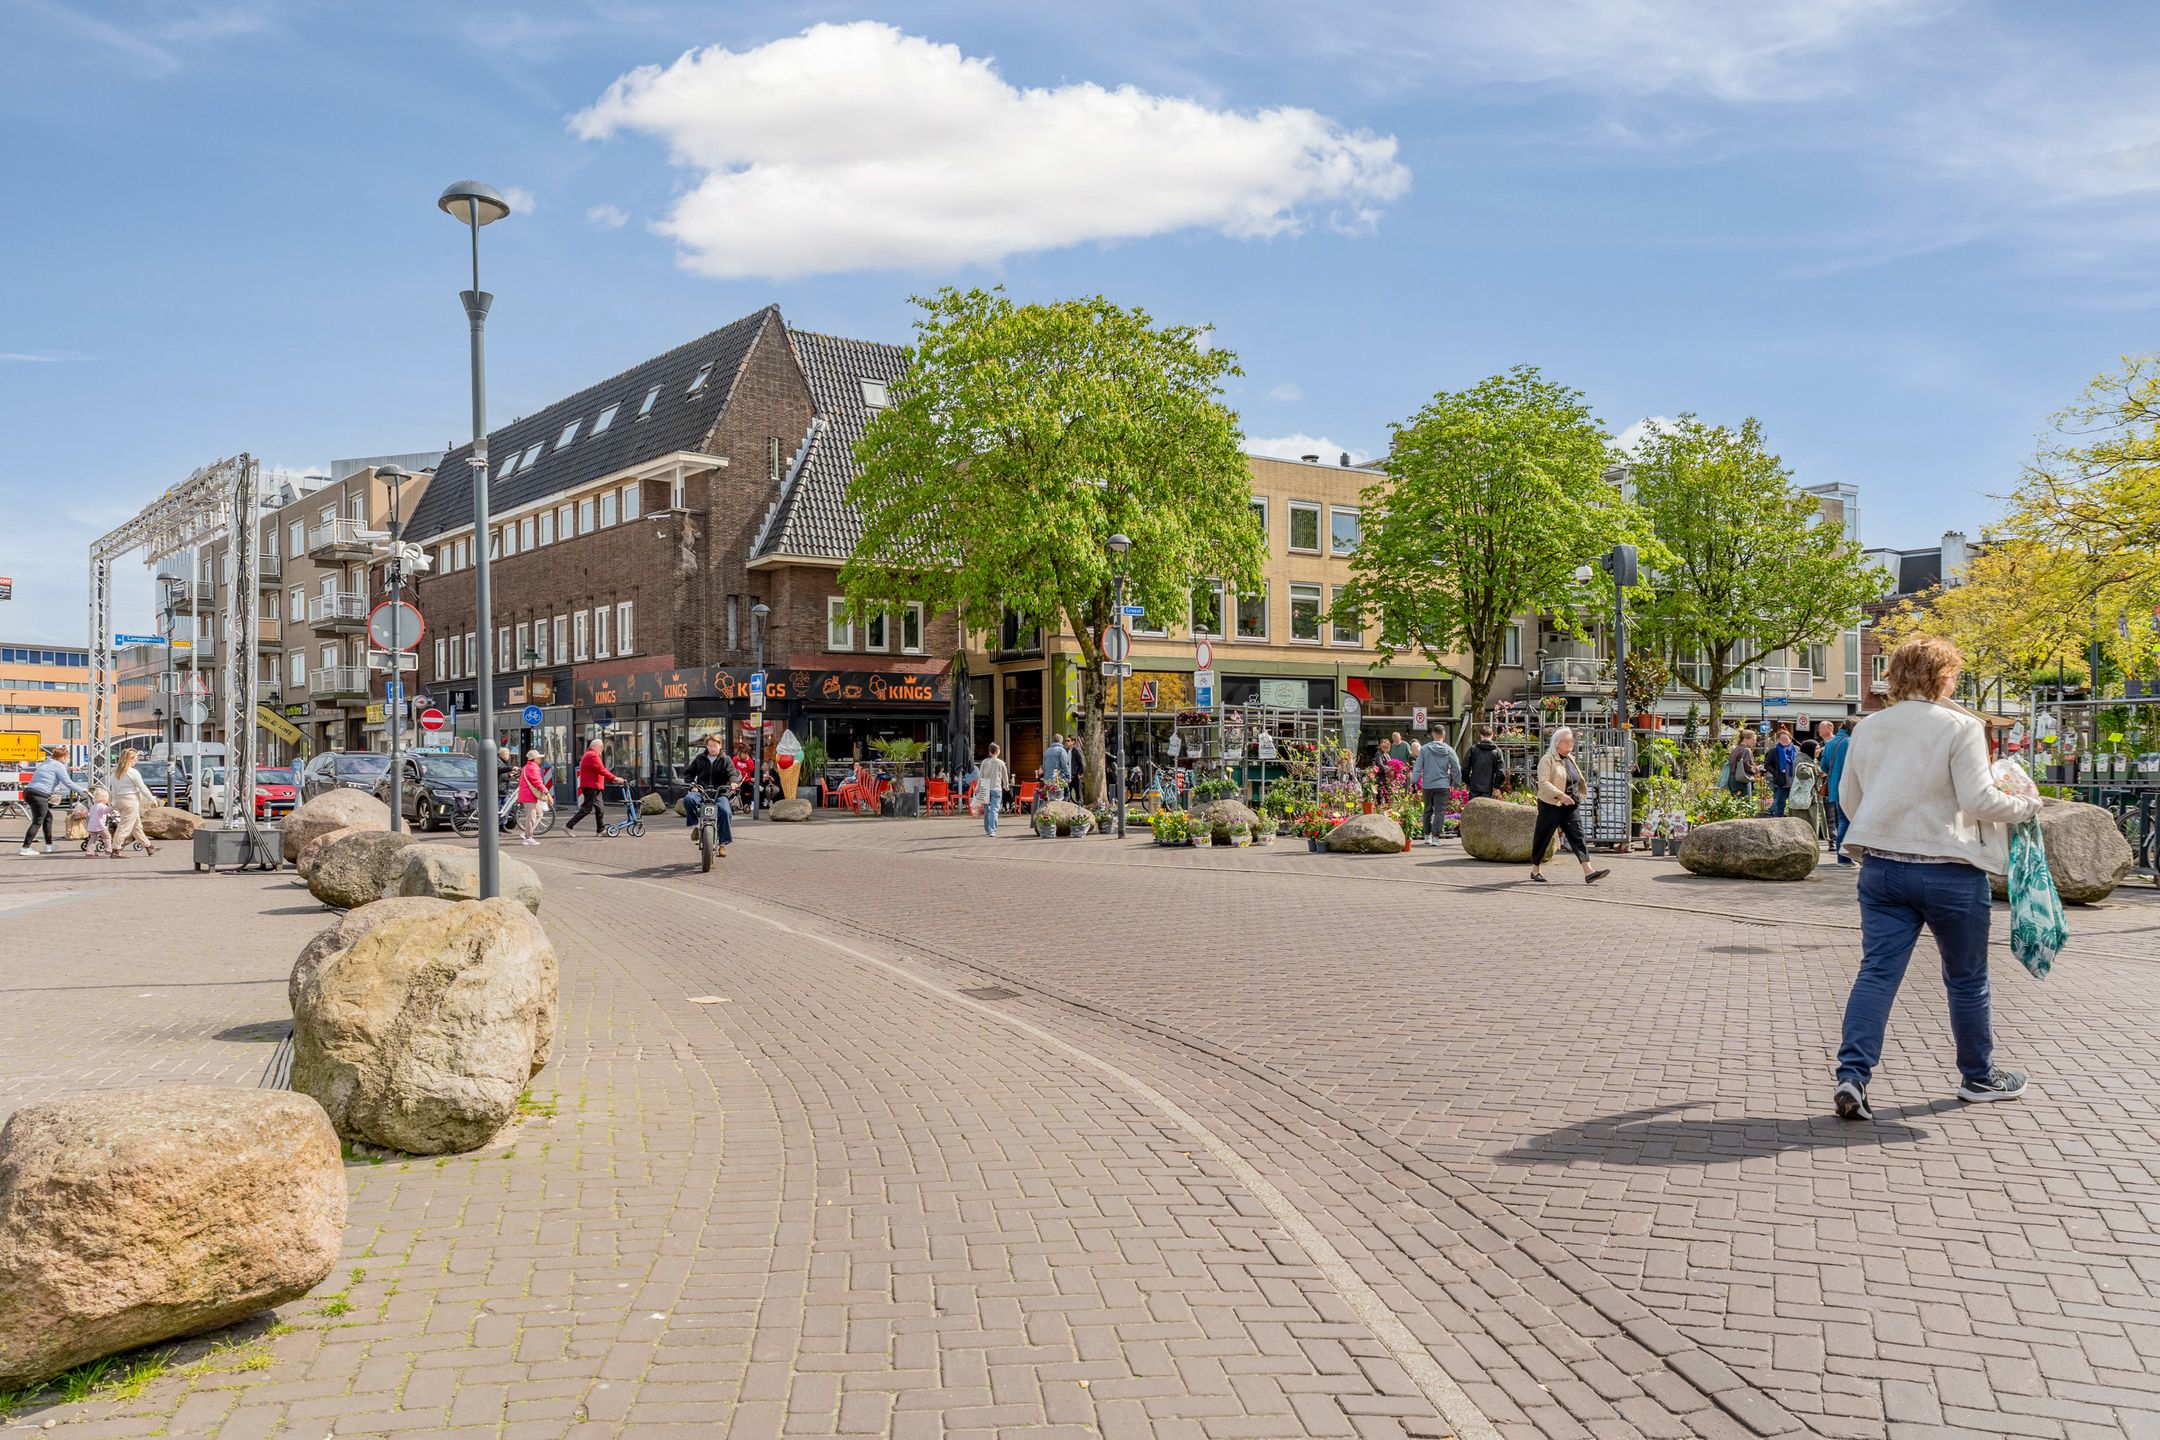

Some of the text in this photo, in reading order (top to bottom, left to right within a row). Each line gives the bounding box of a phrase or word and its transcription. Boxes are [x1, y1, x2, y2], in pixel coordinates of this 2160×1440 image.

[595, 690, 616, 704] KINGS
[664, 683, 688, 698] KINGS
[737, 682, 785, 697] KGS
[889, 685, 932, 700] KINGS
